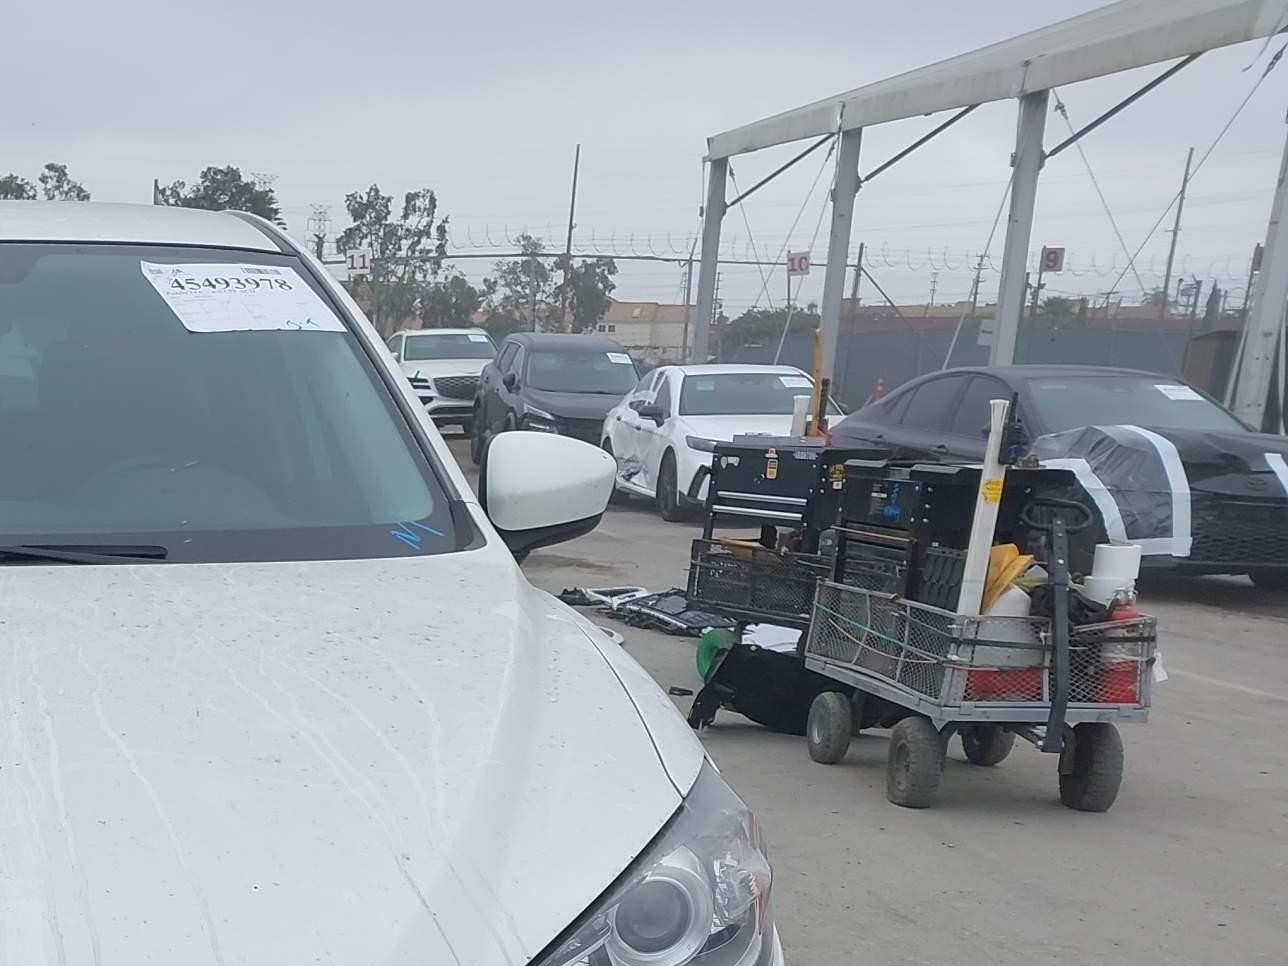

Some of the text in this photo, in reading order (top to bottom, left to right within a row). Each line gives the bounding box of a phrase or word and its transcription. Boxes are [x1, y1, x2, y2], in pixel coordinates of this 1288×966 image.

[348, 254, 369, 270] 11
[787, 256, 809, 272] 10
[1047, 251, 1059, 268] 9
[170, 277, 293, 291] 45493978
